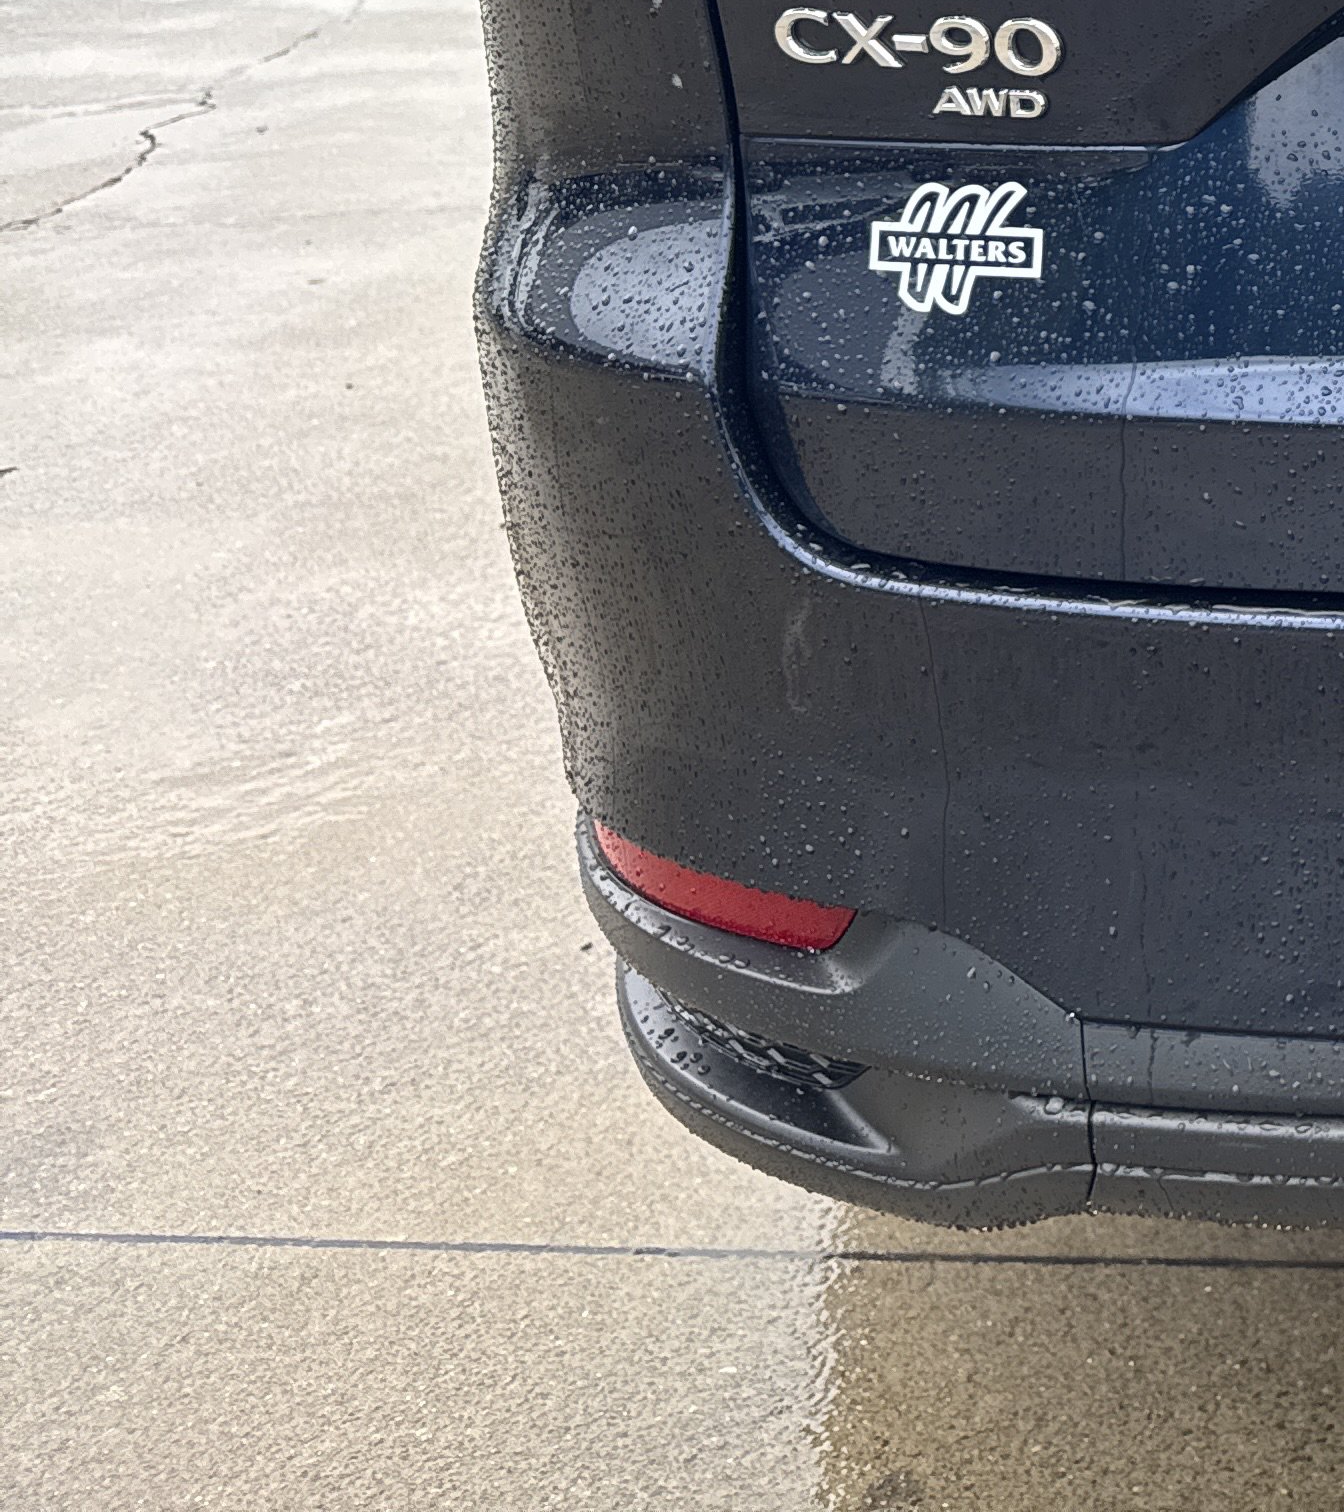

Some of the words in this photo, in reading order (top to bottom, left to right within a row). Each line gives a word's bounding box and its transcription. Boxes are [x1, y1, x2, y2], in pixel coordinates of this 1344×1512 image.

[774, 7, 1064, 77] CX-90
[930, 86, 1048, 119] AWD
[887, 235, 1026, 264] WALTERS
